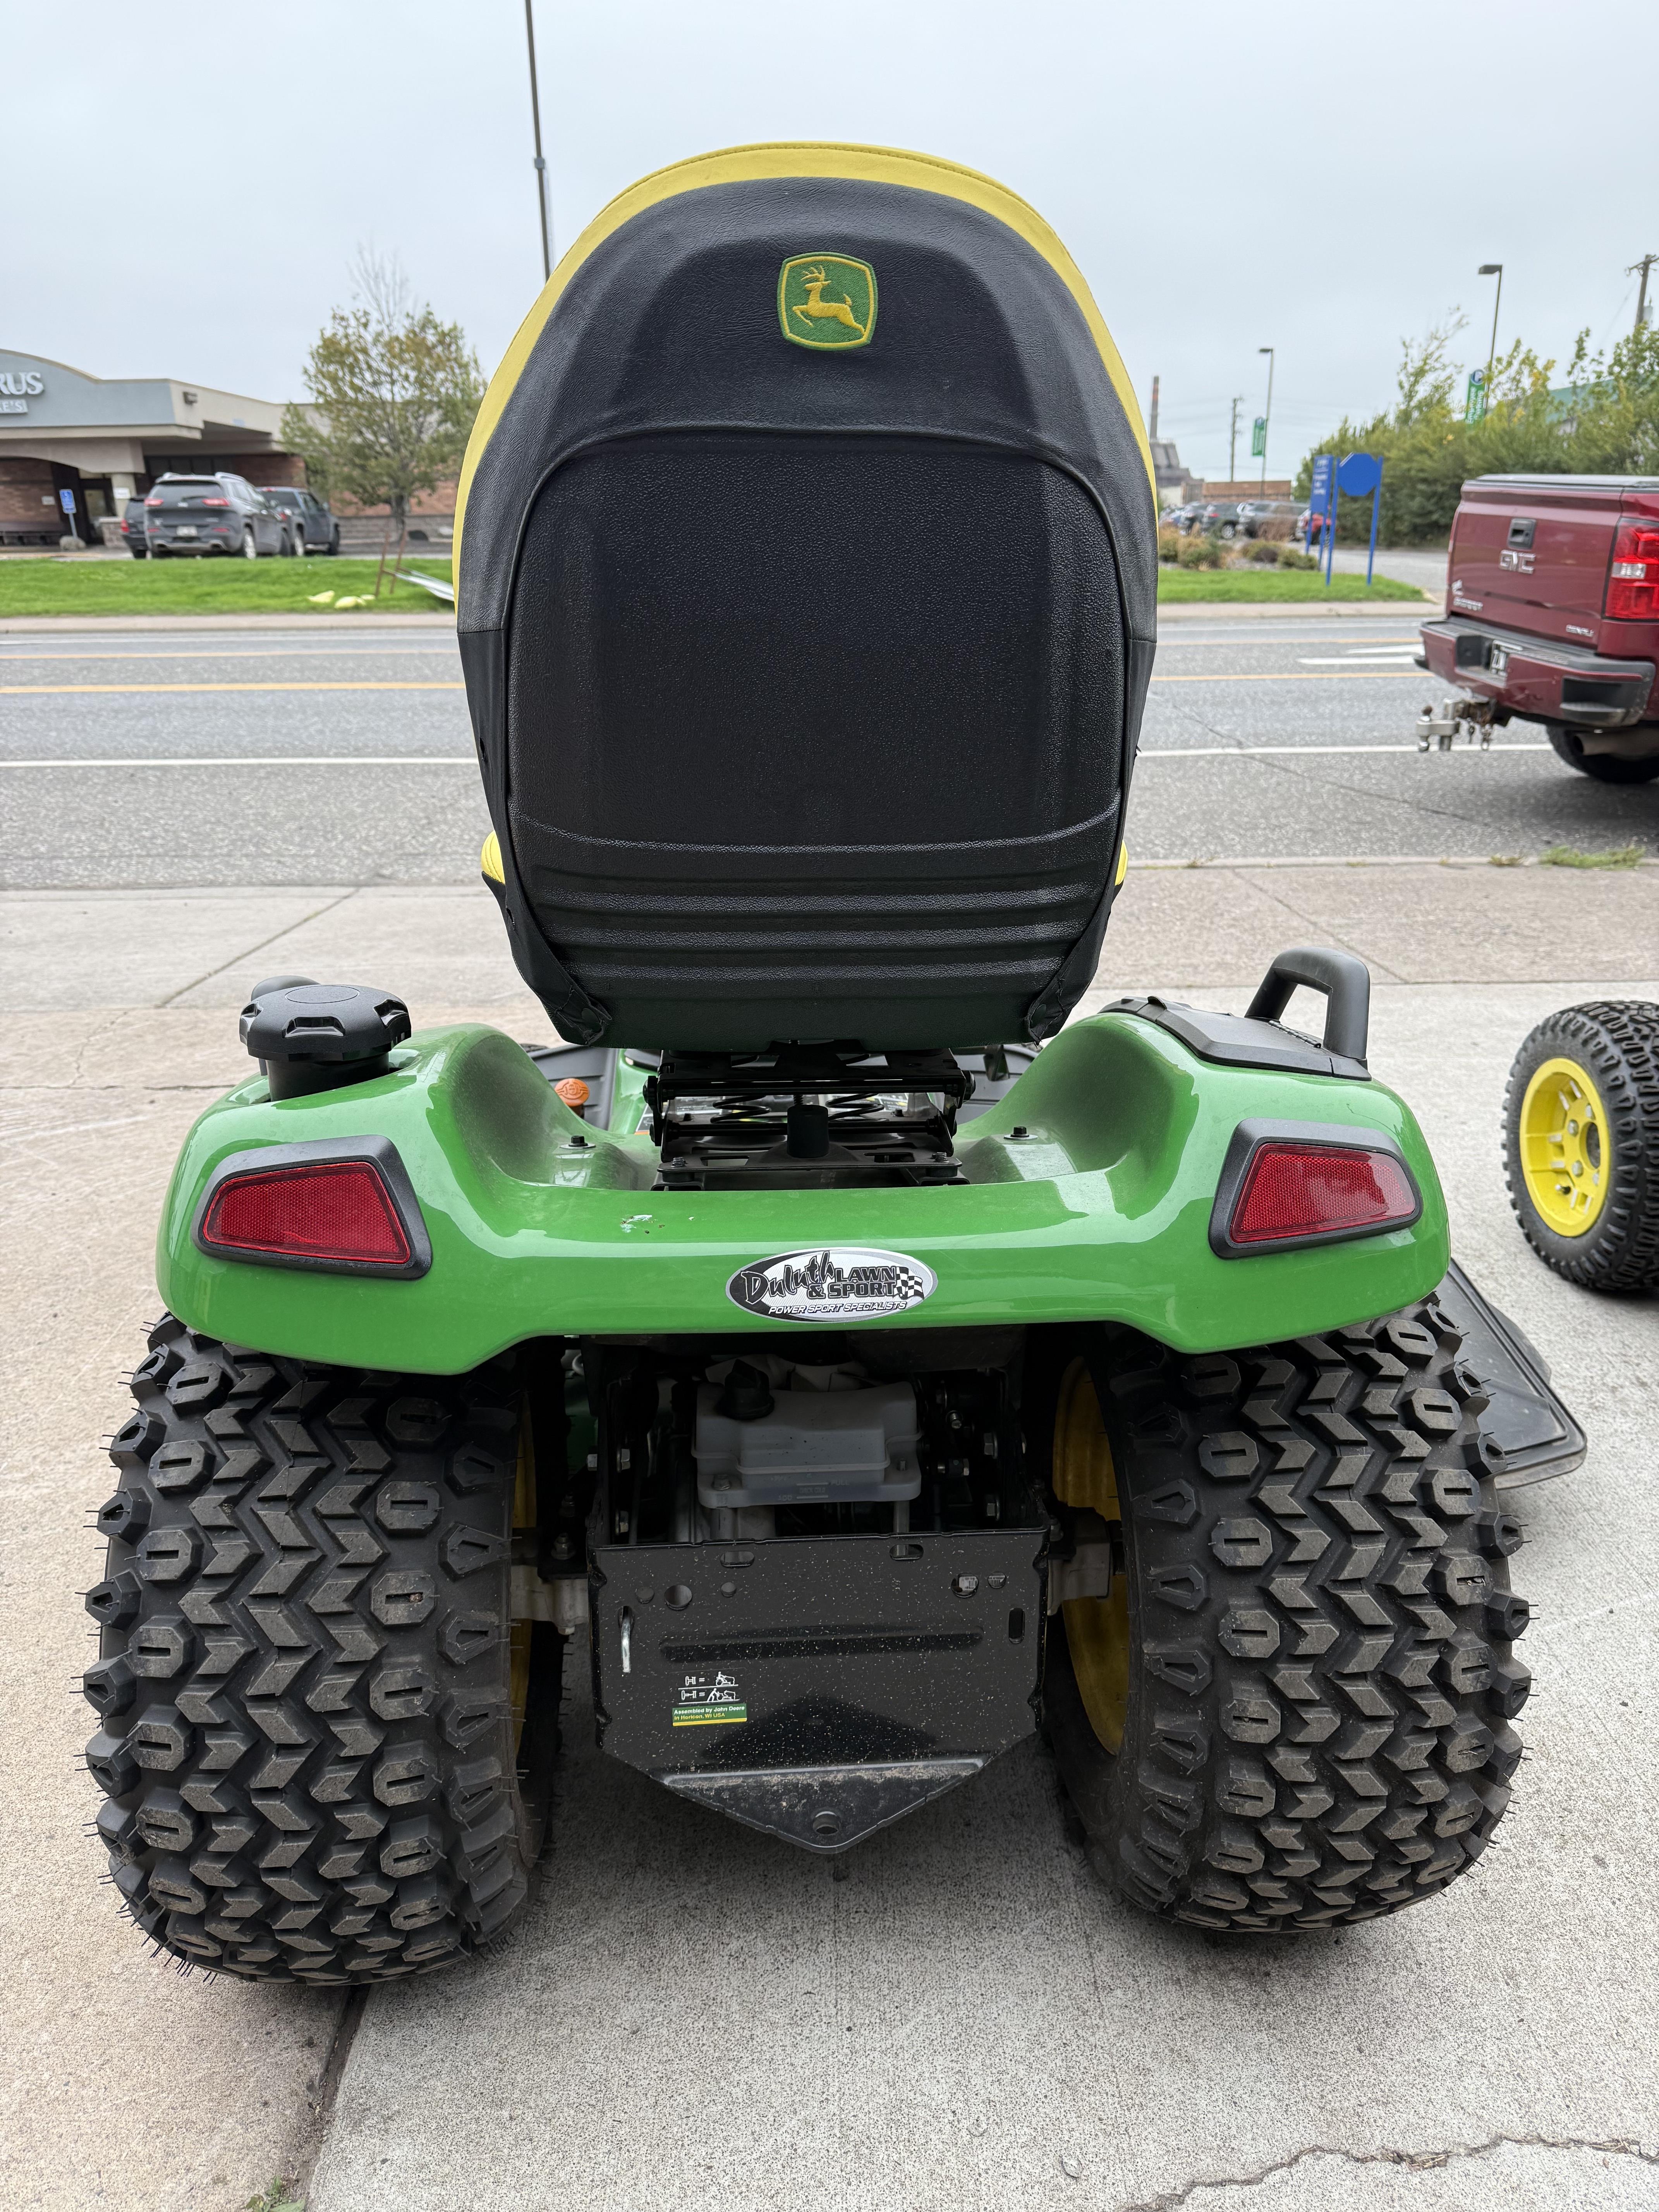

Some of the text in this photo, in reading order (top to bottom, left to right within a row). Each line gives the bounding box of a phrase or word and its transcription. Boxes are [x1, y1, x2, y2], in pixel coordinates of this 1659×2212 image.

[1499, 550, 1536, 574] GMC
[741, 1250, 896, 1304] Duluth LAWN
[807, 1282, 896, 1299] & SPORT
[768, 1301, 907, 1314] POWER SPORT SPECIALISTS
